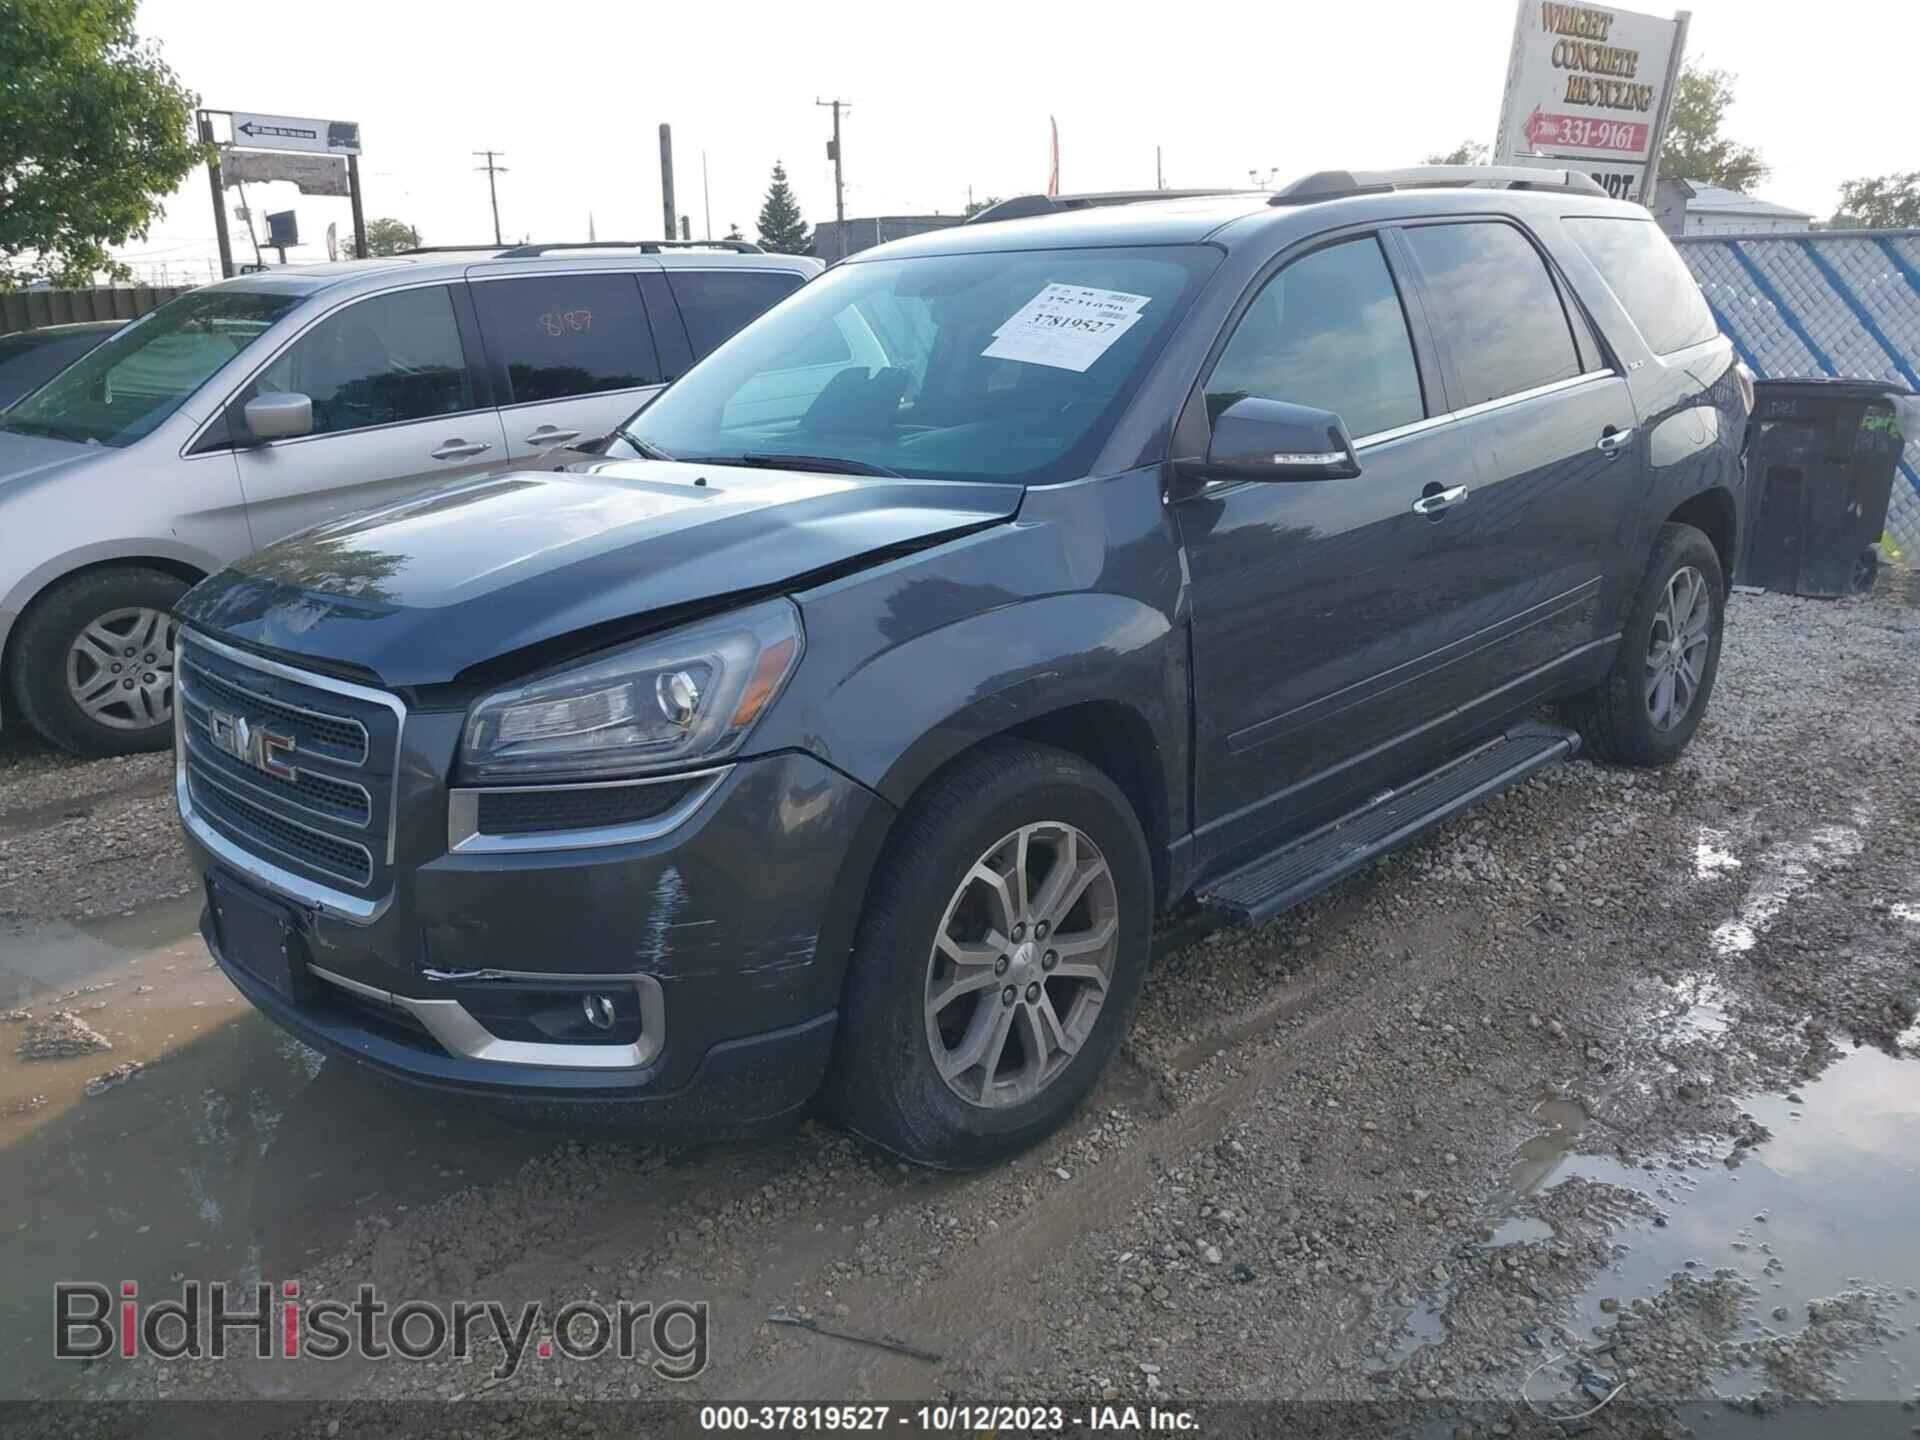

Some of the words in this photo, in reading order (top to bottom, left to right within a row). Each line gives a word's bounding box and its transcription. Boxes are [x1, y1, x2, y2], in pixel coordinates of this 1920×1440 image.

[1552, 39, 1640, 78] CONCRETE
[1563, 75, 1654, 112] RECYCLING
[1558, 118, 1634, 149] 331-9161
[1033, 313, 1115, 333] 37819527
[208, 708, 297, 782] GMC
